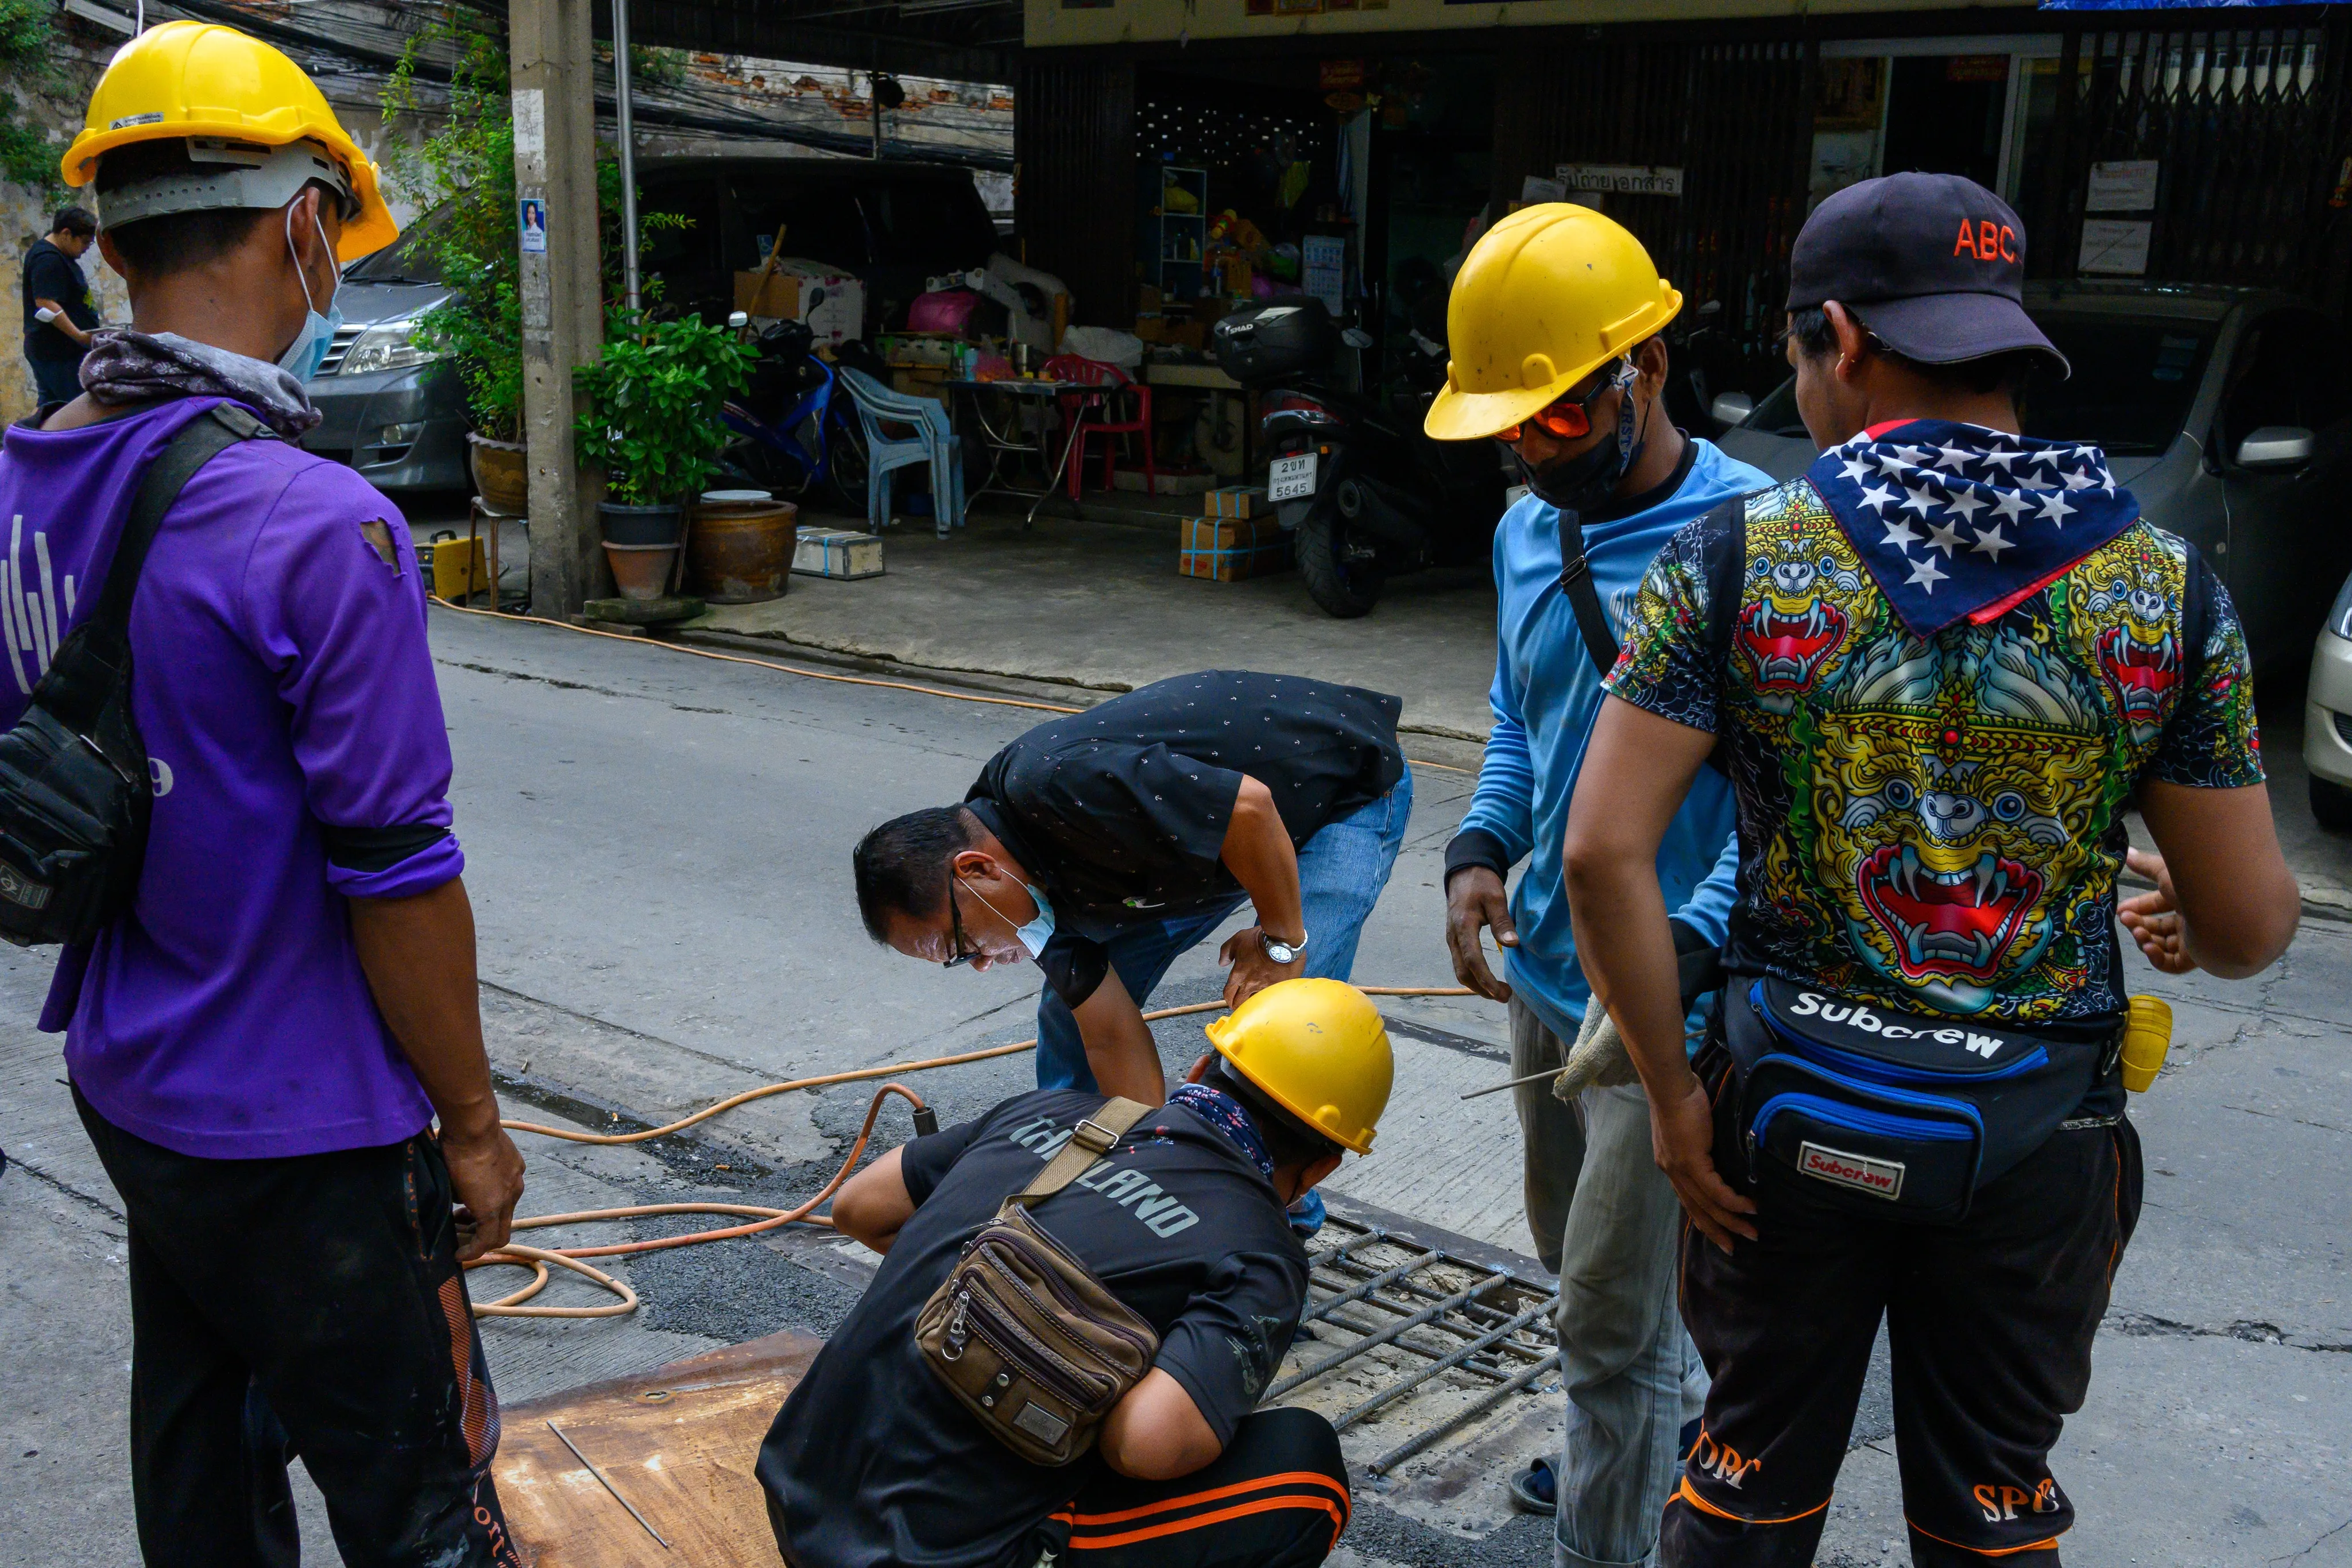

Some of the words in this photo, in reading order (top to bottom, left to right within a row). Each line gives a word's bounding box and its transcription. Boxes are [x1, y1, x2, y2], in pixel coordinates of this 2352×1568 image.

[1953, 218, 2016, 264] ABC
[1229, 323, 1254, 335] SHAD
[1620, 396, 1633, 448] IRST
[1276, 483, 1307, 497] 5645
[1790, 993, 2004, 1059] Subcrew
[1009, 1116, 1200, 1238] THLAND
[1807, 1154, 1893, 1188] Subcrew
